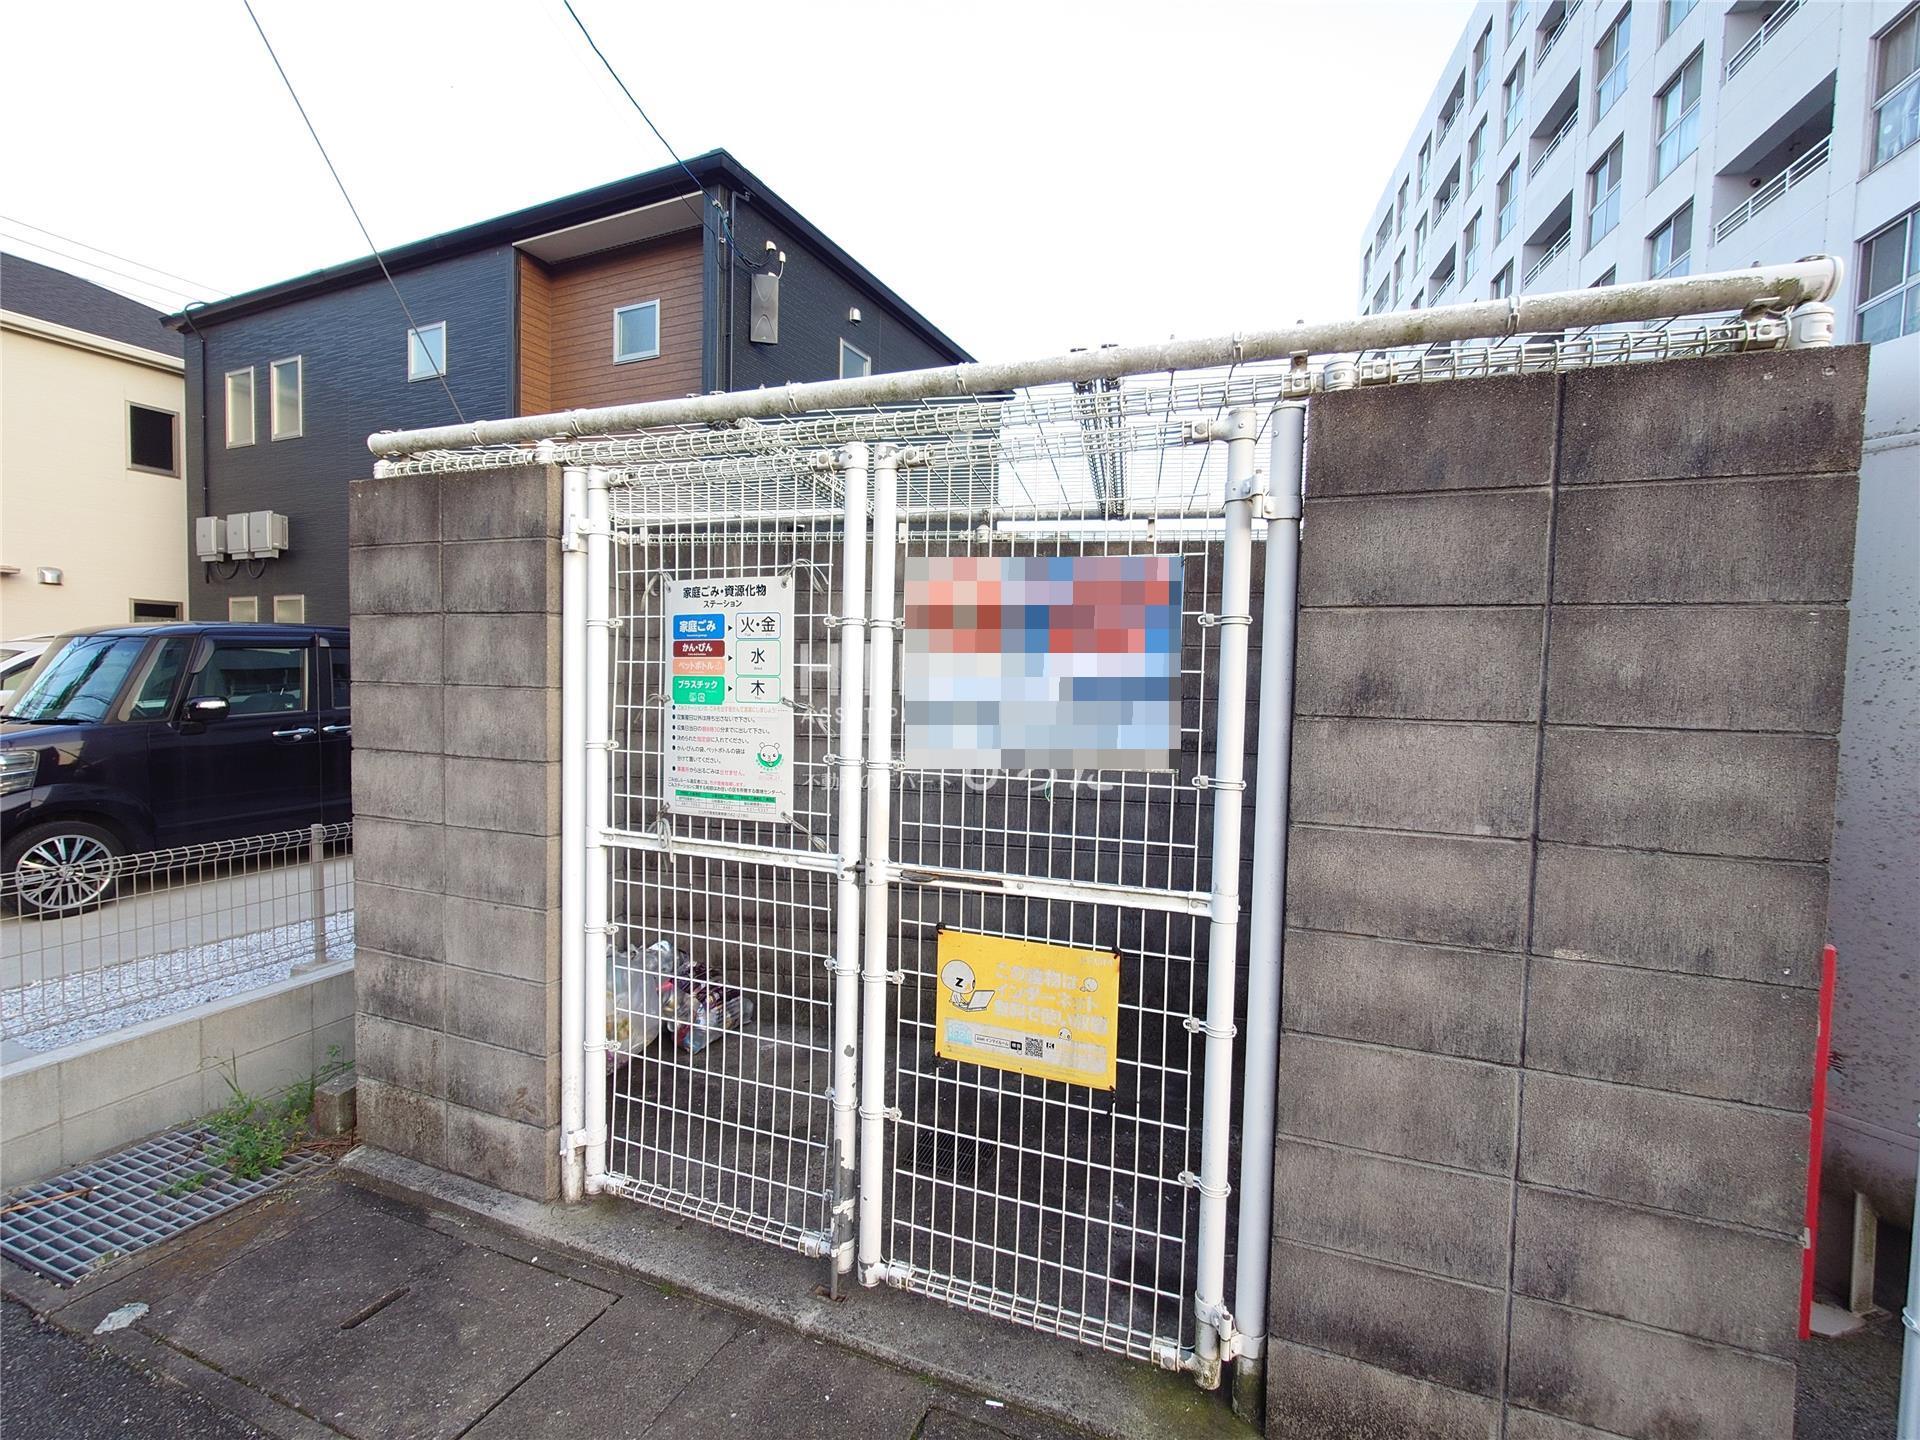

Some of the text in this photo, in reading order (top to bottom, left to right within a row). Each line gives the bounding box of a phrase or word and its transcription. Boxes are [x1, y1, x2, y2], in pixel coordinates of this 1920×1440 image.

[682, 584, 767, 598] 家庭ごみ・資源化物
[703, 599, 743, 608] ステーション
[679, 619, 716, 632] 家庭ごみ
[740, 615, 776, 633] 火・金
[682, 642, 713, 653] かん・びん
[750, 647, 766, 664] 水
[677, 679, 718, 689] プラスチック
[750, 679, 766, 696] 木
[997, 984, 1098, 1012] インターネット
